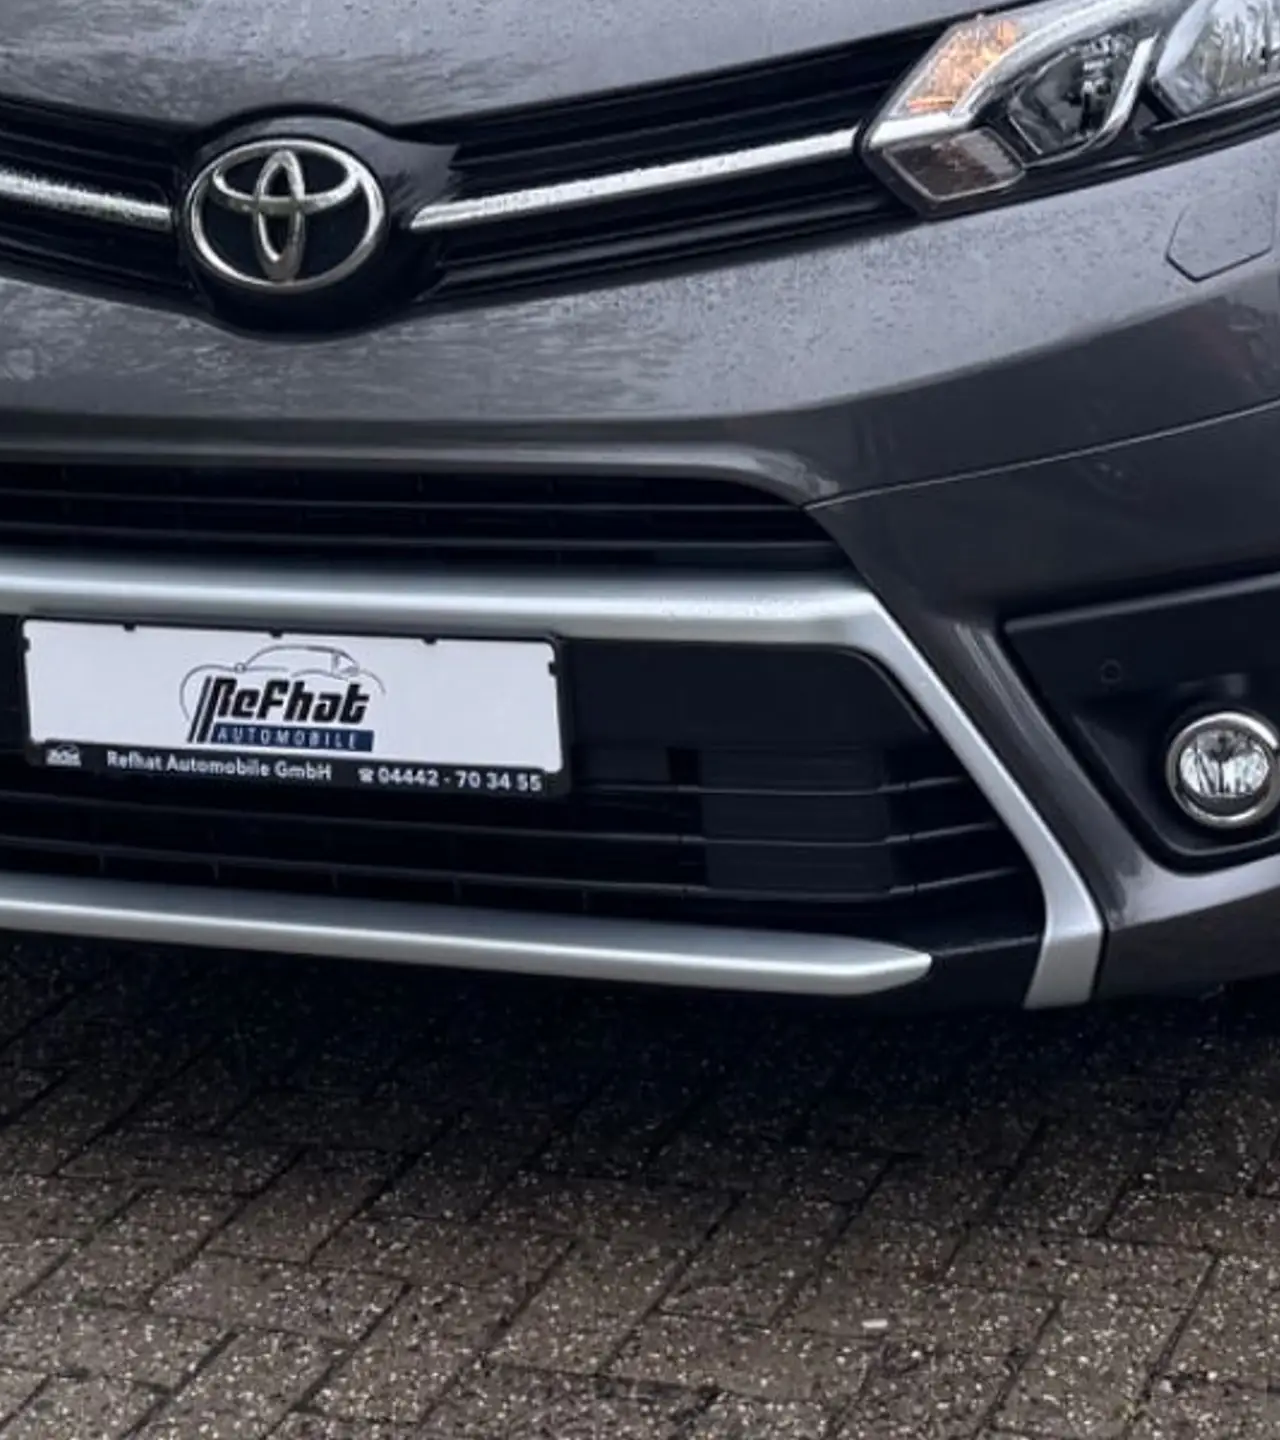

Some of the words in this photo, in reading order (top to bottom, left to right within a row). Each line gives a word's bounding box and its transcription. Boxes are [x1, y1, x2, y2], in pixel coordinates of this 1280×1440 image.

[217, 727, 357, 750] AUTOMOBILE
[106, 749, 161, 770] Refhat
[166, 753, 270, 778] Automobile
[274, 760, 333, 781] GmbH
[455, 770, 481, 788] 70
[486, 772, 512, 790] 34
[516, 773, 542, 792] 55
